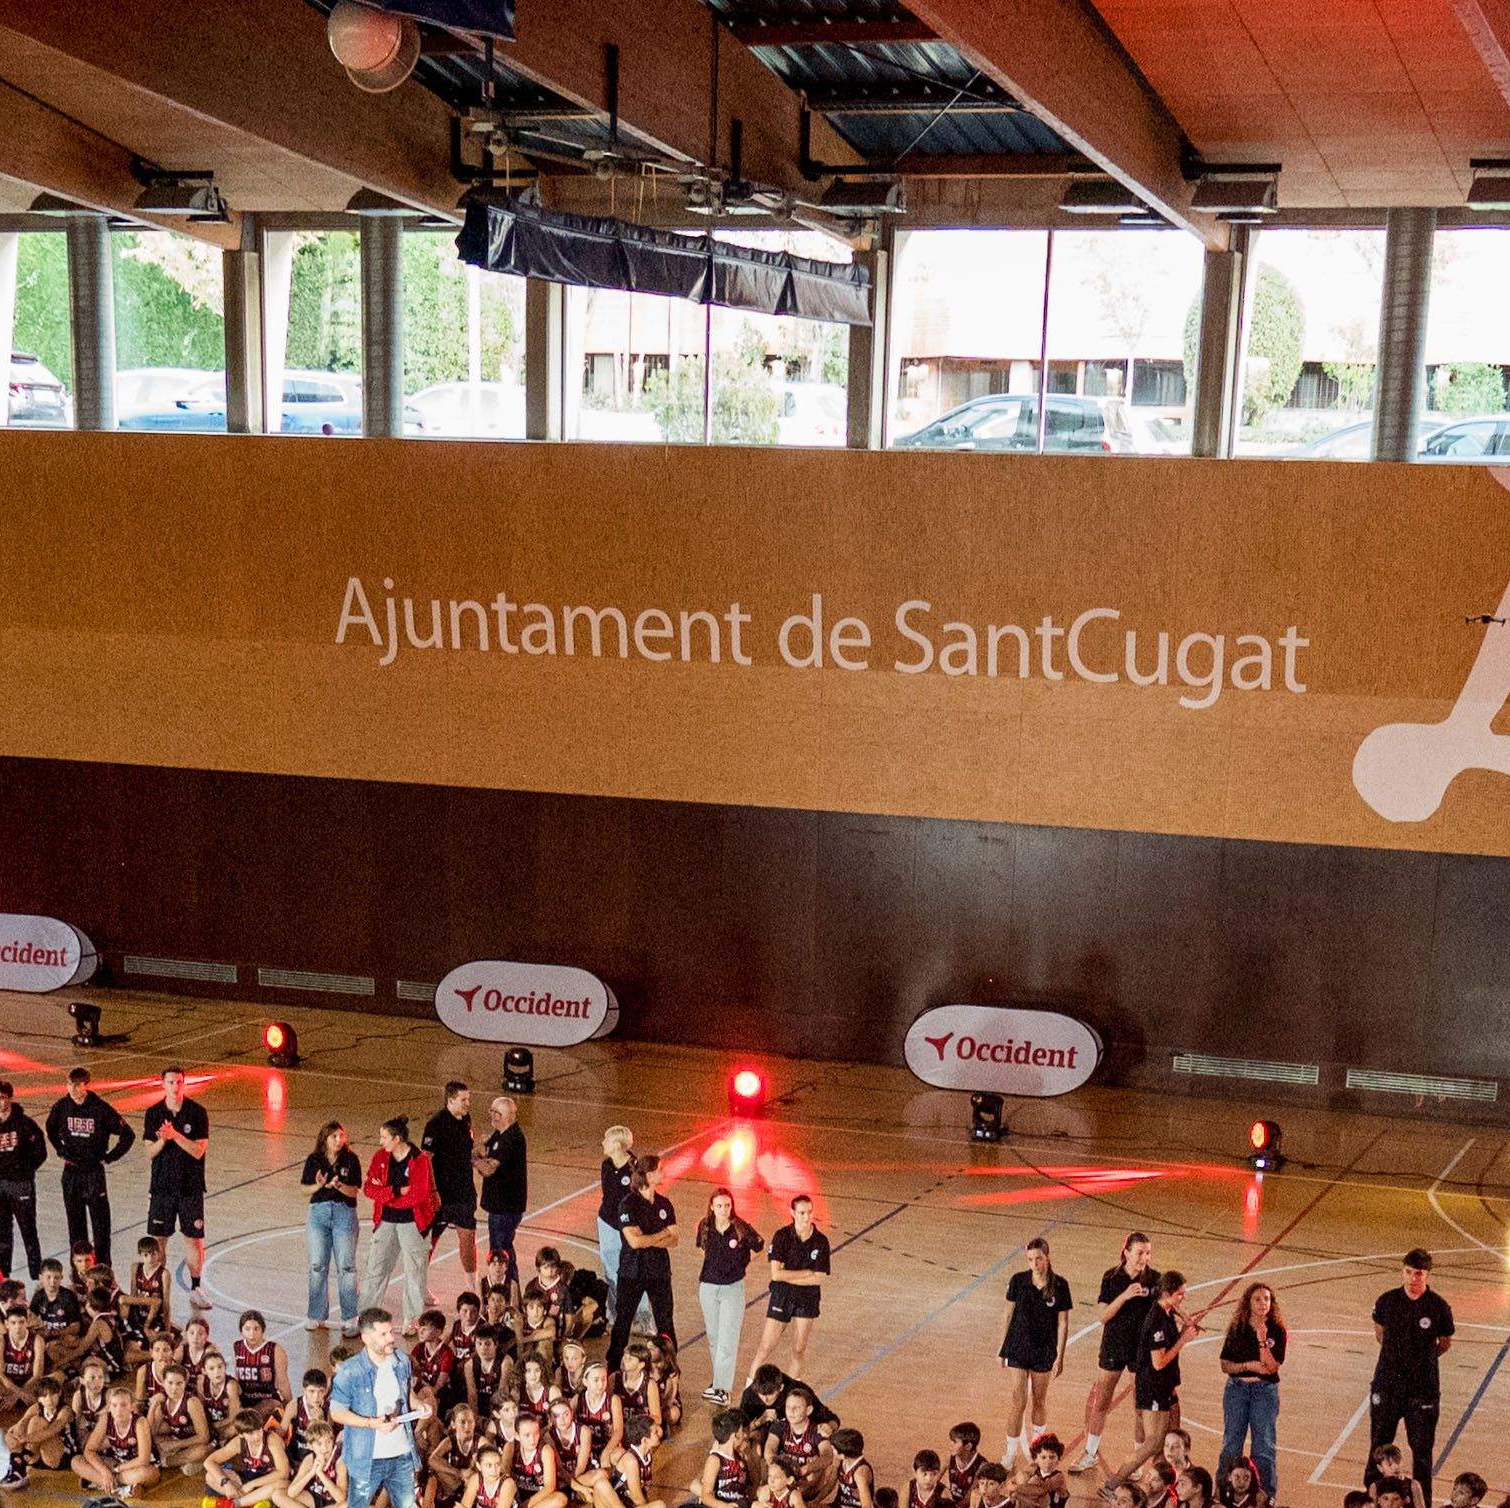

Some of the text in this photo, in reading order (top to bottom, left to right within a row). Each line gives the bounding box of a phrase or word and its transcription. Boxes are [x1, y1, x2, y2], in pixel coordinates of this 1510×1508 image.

[334, 577, 1310, 709] Ajuntament de SantCugat
[482, 988, 592, 1020] Occident
[955, 1034, 1078, 1069] Occident
